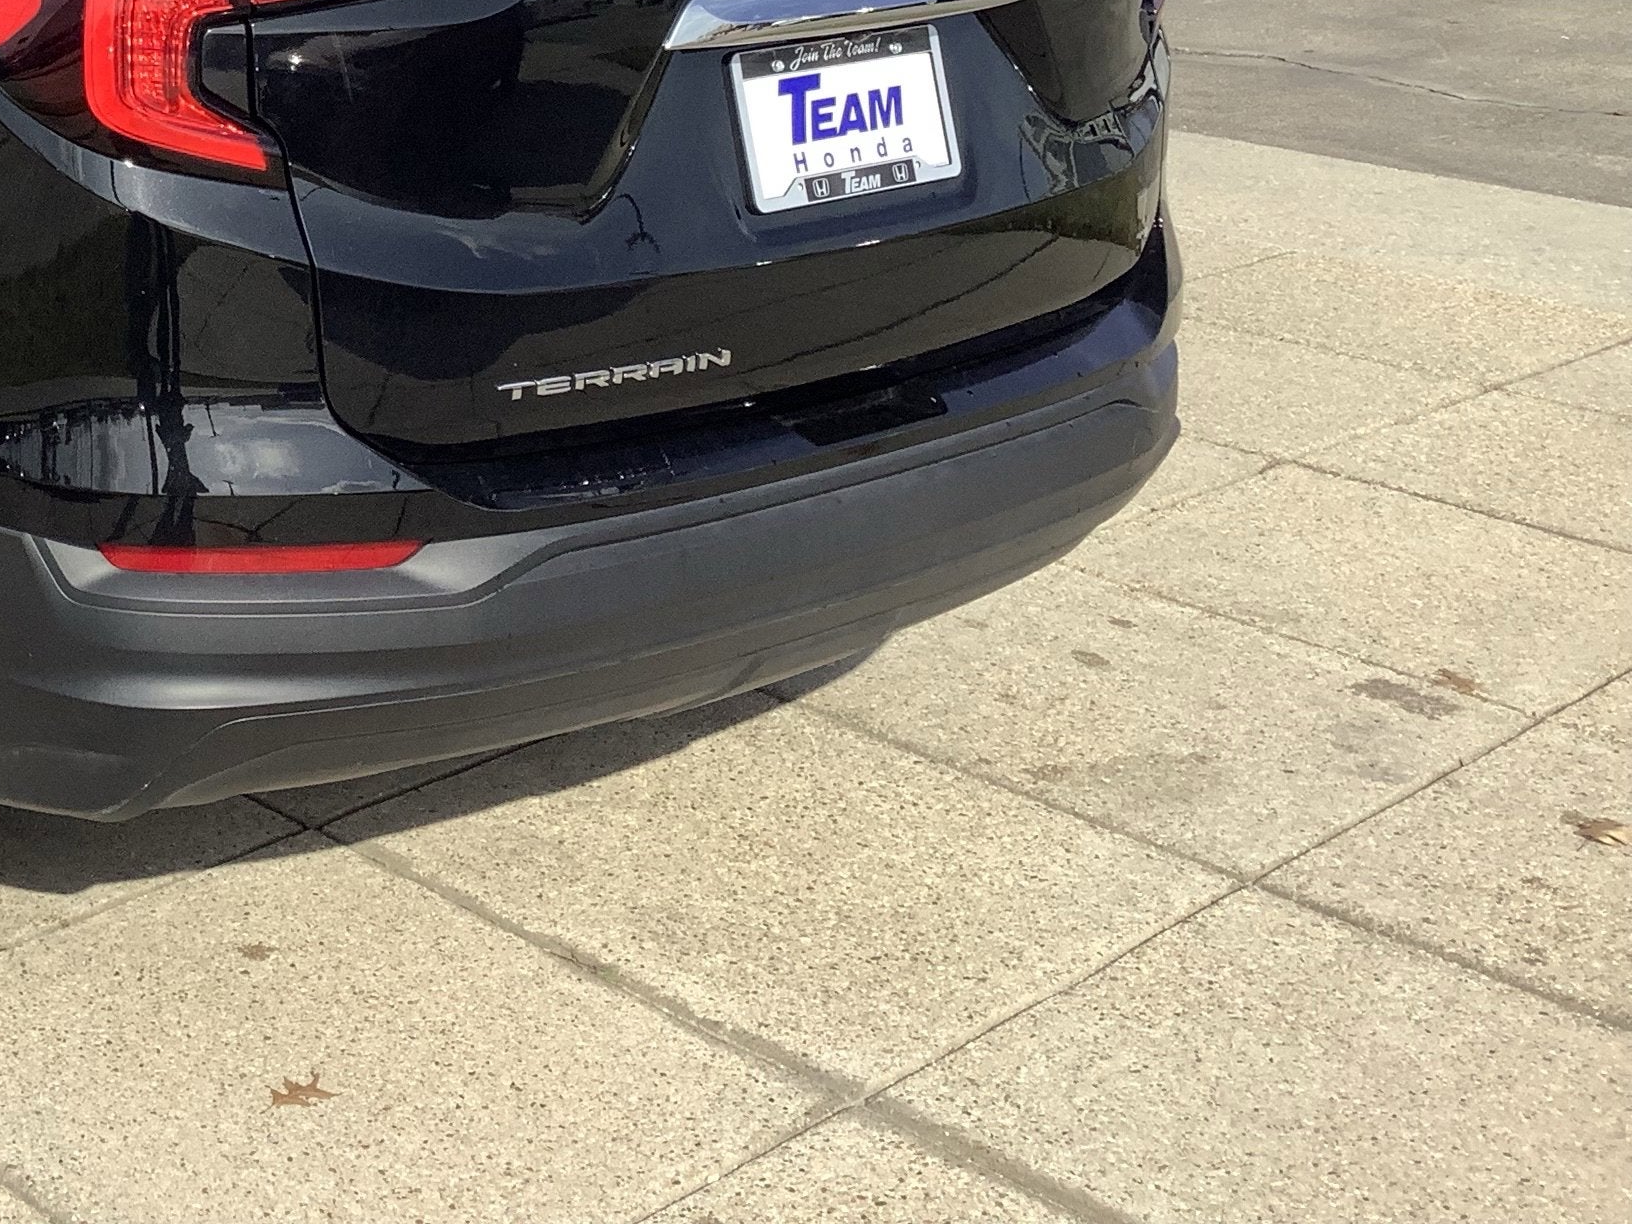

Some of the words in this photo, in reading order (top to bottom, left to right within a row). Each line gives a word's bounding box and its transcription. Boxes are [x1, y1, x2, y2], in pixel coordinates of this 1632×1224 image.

[789, 45, 819, 71] Join
[820, 42, 843, 61] The
[843, 36, 882, 57] Team!
[777, 73, 904, 146] TEAM
[793, 137, 914, 174] Honda
[841, 171, 882, 194] TEAM
[496, 349, 732, 400] TERRAIN
